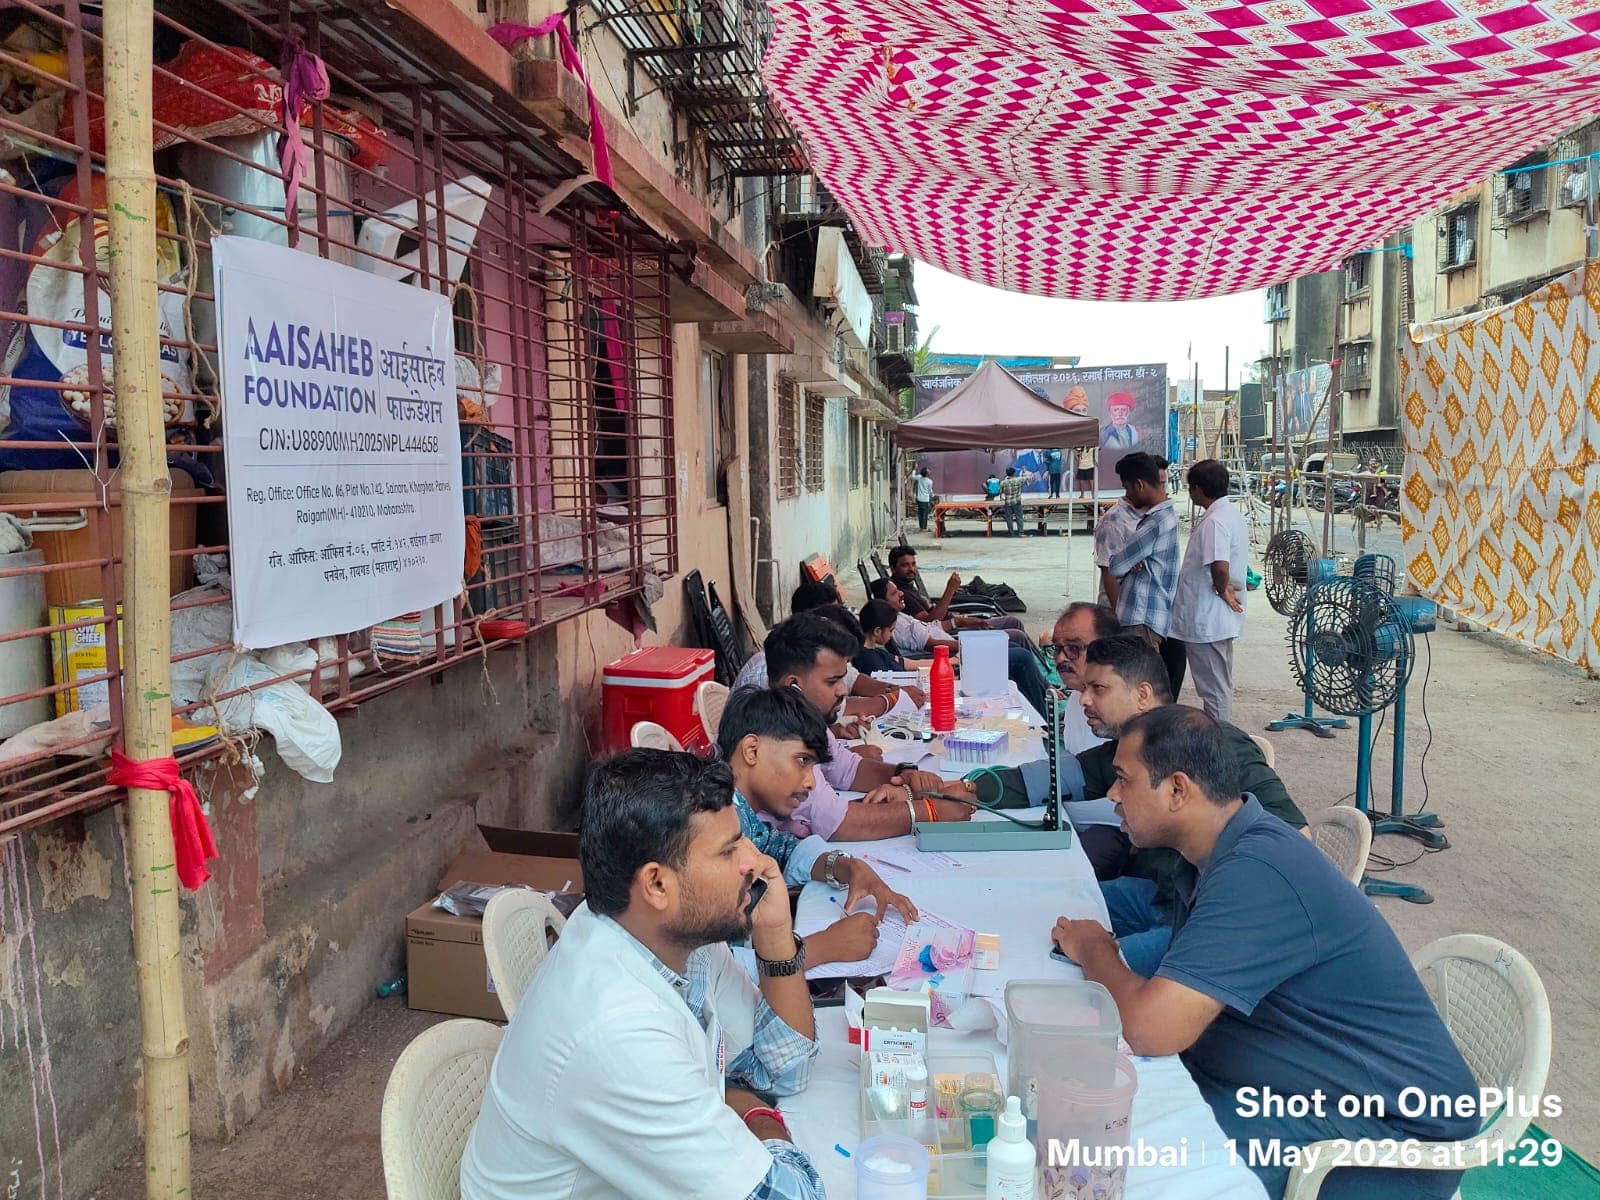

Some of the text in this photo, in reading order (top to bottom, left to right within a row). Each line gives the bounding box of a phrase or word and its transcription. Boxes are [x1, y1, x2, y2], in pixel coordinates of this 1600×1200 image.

[244, 315, 374, 377] AAISAHEB
[380, 341, 446, 391] आईसाहेब
[244, 374, 376, 415] FOUNDATION
[386, 389, 443, 424] फाऊंडेशन
[259, 427, 439, 453] CIN:U88900MH2025NPL444658
[246, 487, 266, 505] Reg.
[267, 486, 294, 502] Office:
[295, 485, 320, 500] Office
[321, 484, 334, 498] No.
[345, 483, 359, 497] Plot
[350, 504, 376, 519] 410210,
[268, 550, 286, 569] रजि.
[288, 546, 318, 565] ऑफिस:
[320, 543, 345, 561] ऑफिस
[324, 564, 348, 582] पनवेल,
[75, 632, 100, 643] GHEE
